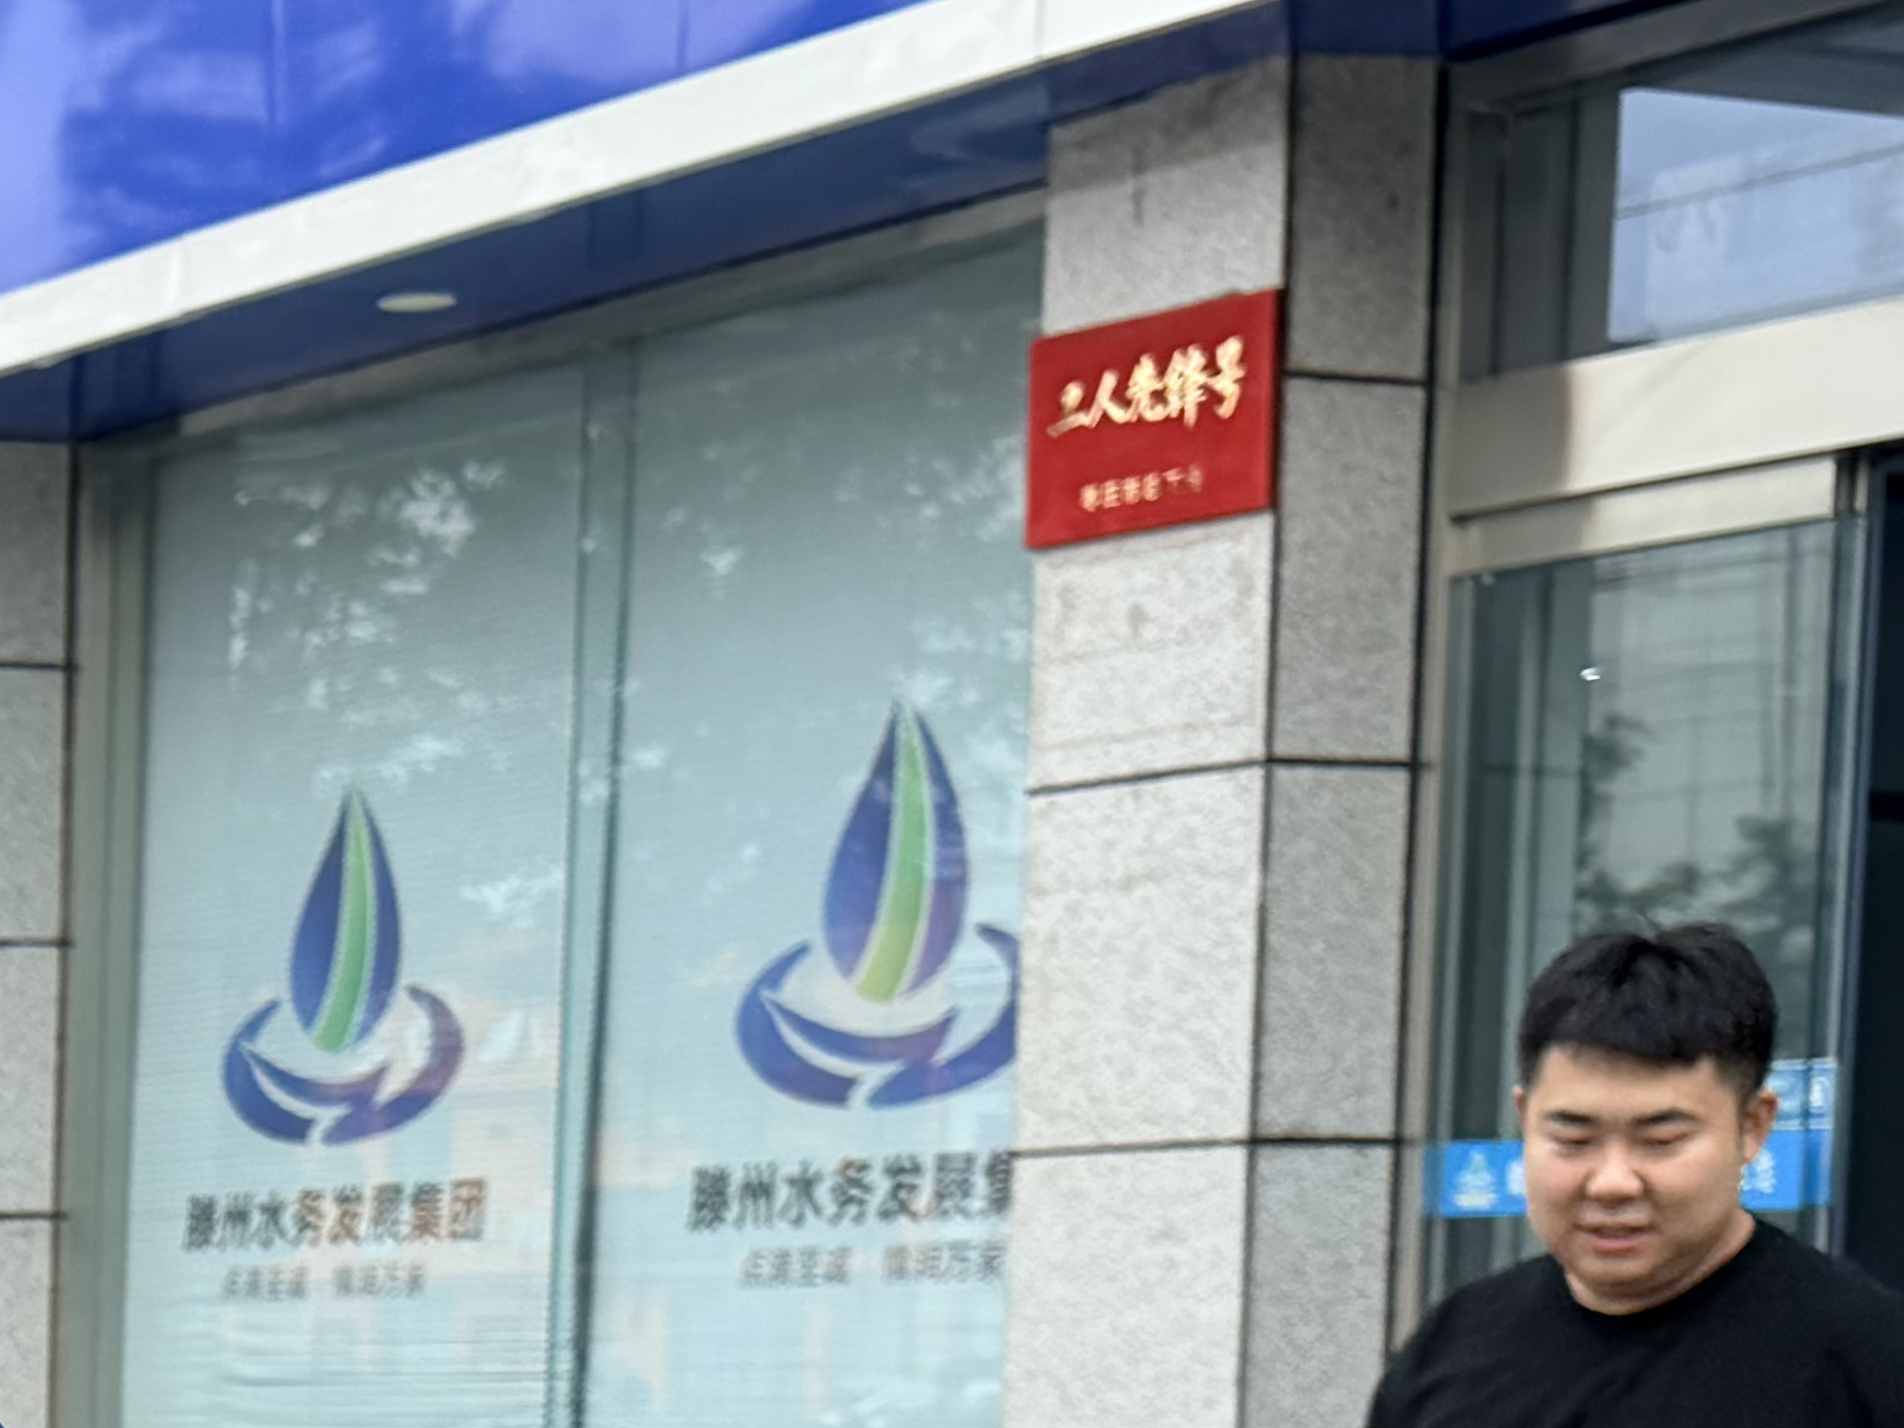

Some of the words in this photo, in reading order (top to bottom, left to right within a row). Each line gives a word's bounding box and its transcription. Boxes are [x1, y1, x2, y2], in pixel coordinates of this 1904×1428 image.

[182, 1178, 488, 1252] 滕州水务发展集团
